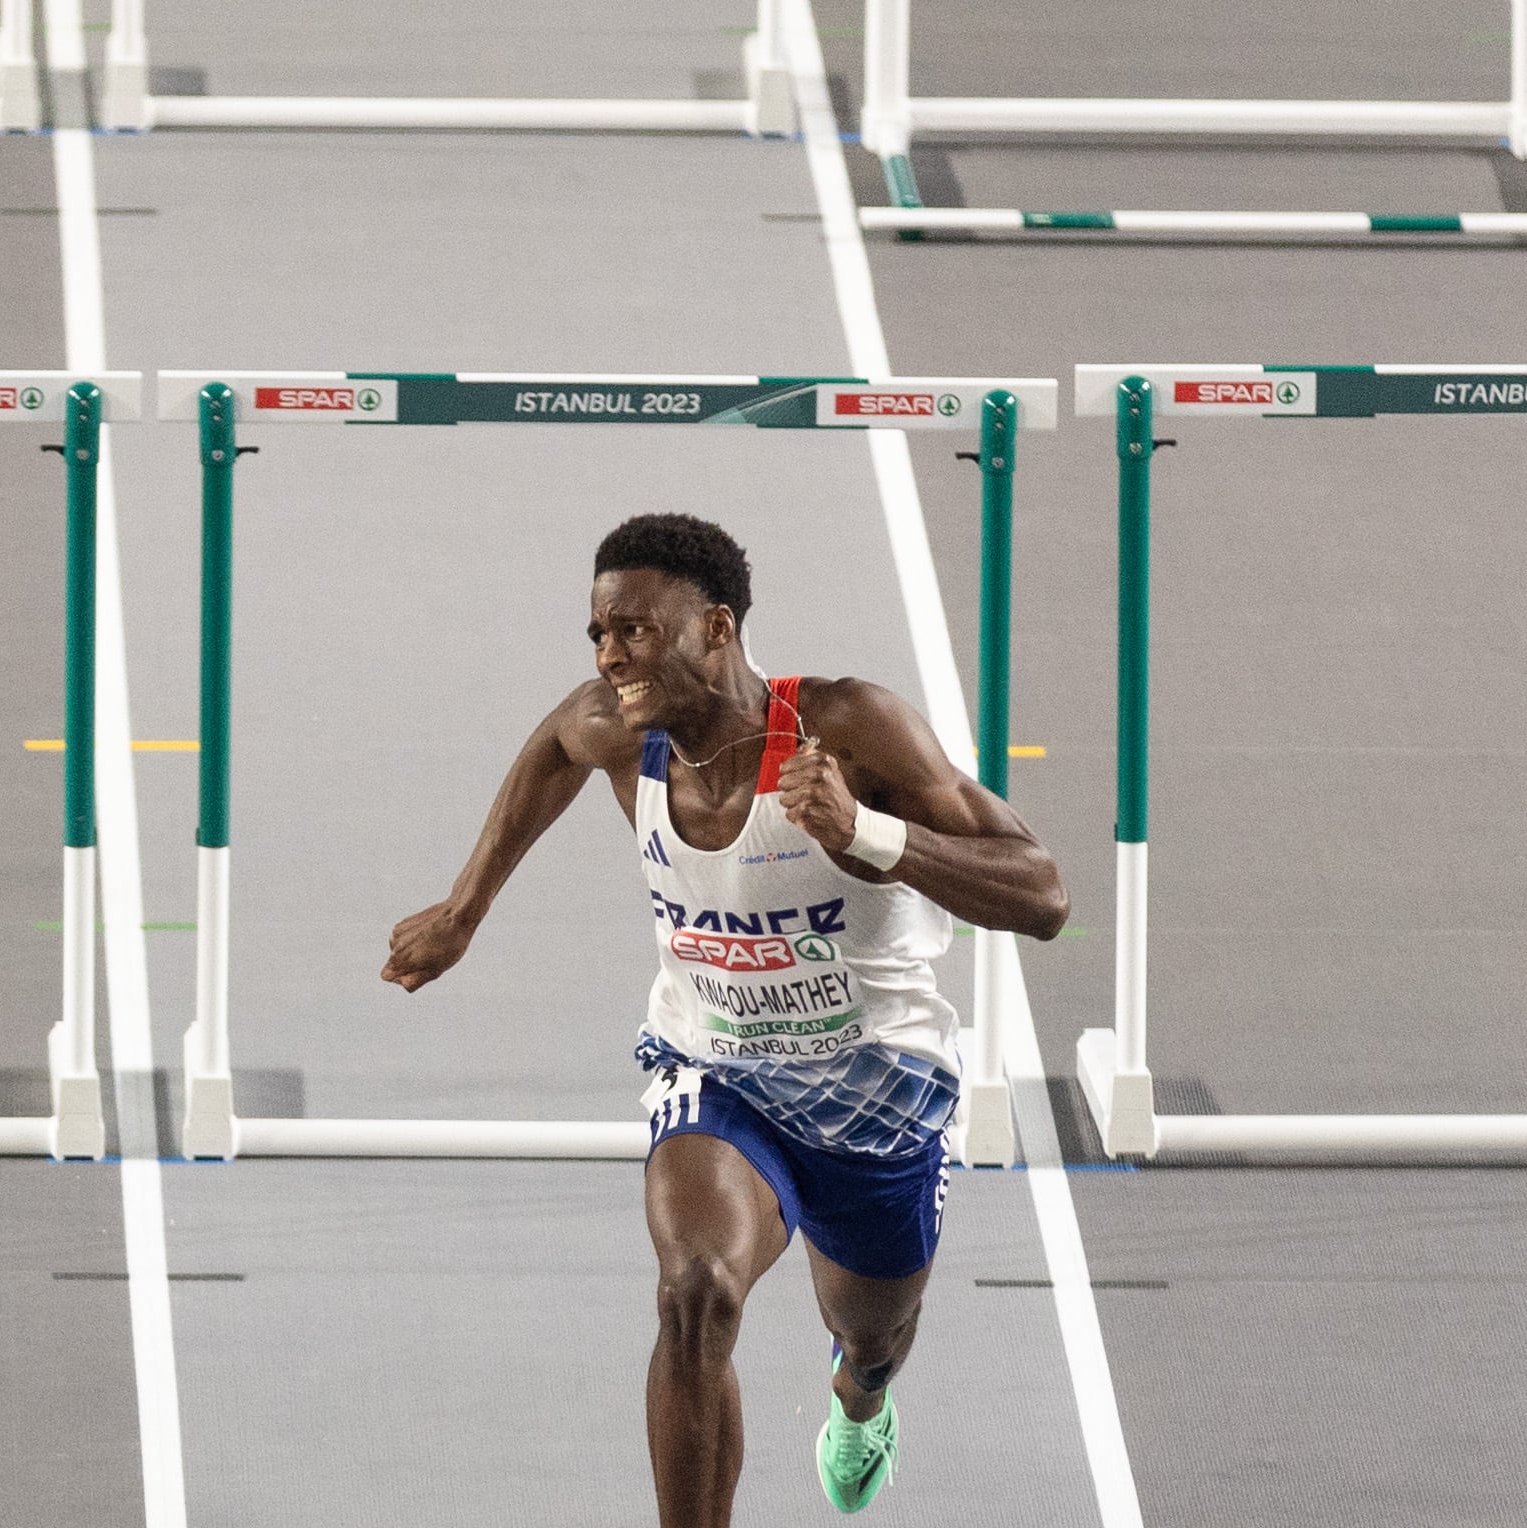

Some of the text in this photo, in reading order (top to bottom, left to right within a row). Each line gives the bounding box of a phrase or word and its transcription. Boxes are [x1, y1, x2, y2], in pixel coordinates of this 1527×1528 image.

[278, 389, 353, 407] SPAR
[515, 392, 701, 413] ISTANBUL 2023
[1198, 384, 1271, 401] SPAR
[1434, 384, 1527, 404] ISTANB
[859, 396, 934, 414] SPAR
[738, 849, 809, 865] Crédit Mutuel
[650, 889, 845, 935] FRANCE
[673, 935, 790, 967] SPAR
[689, 971, 852, 1017] KWAOU-MATHEY
[711, 1024, 862, 1056] ISTANBUL 2023
[736, 1024, 769, 1037] RUN
